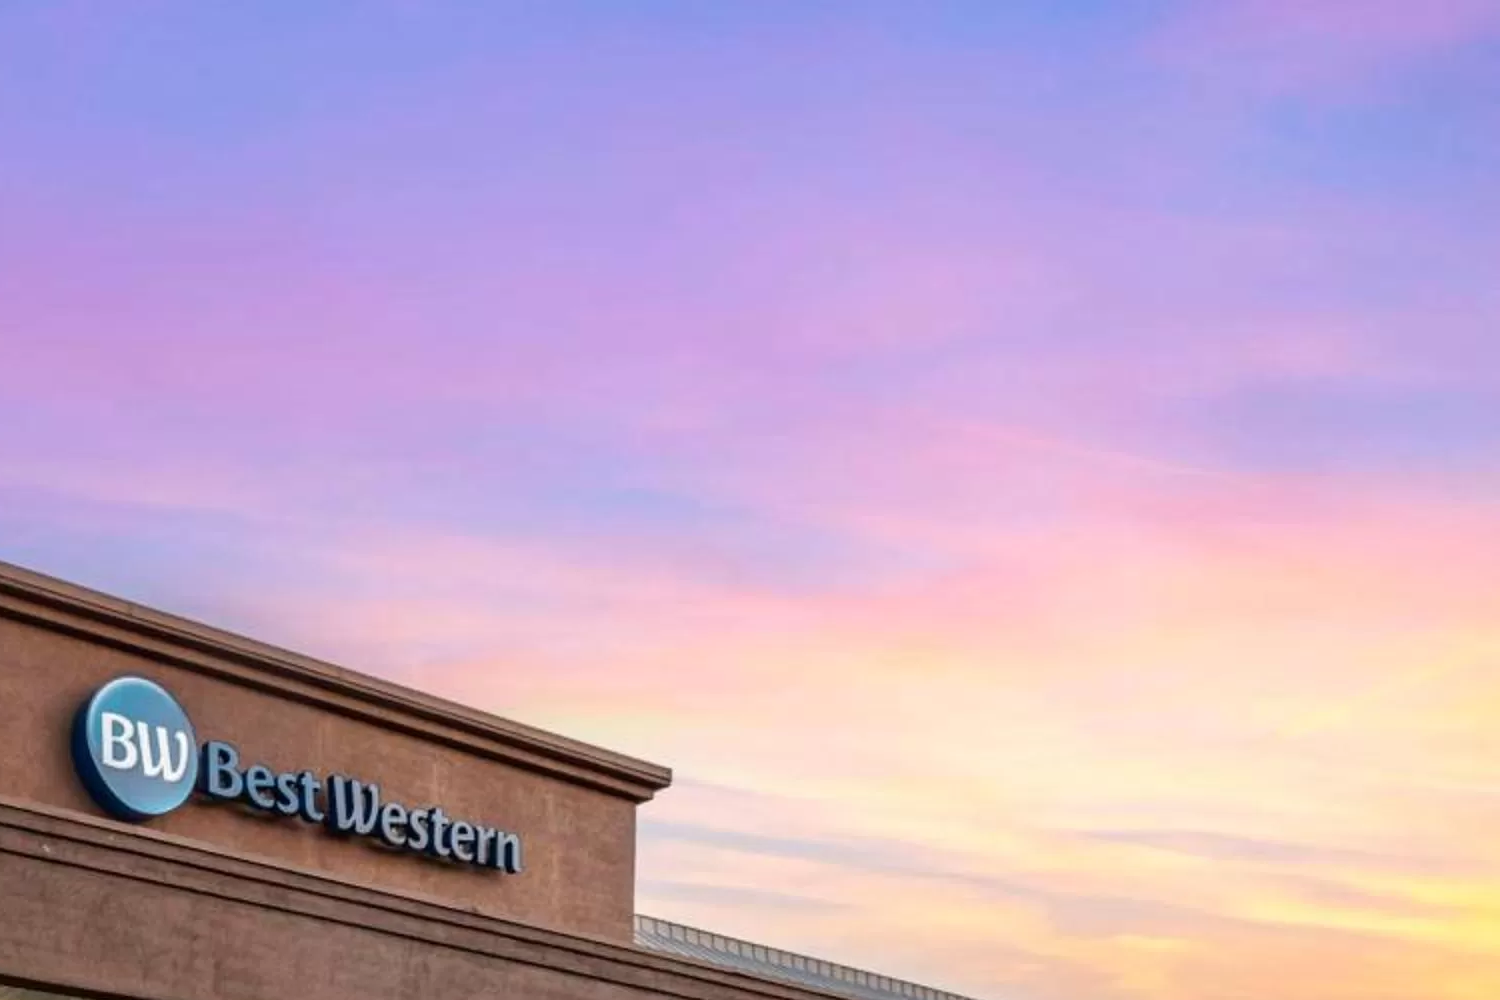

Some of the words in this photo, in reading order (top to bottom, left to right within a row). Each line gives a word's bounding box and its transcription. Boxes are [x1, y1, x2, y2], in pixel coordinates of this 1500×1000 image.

[101, 711, 189, 783] BW
[204, 740, 324, 822] Best
[329, 775, 523, 874] Western
